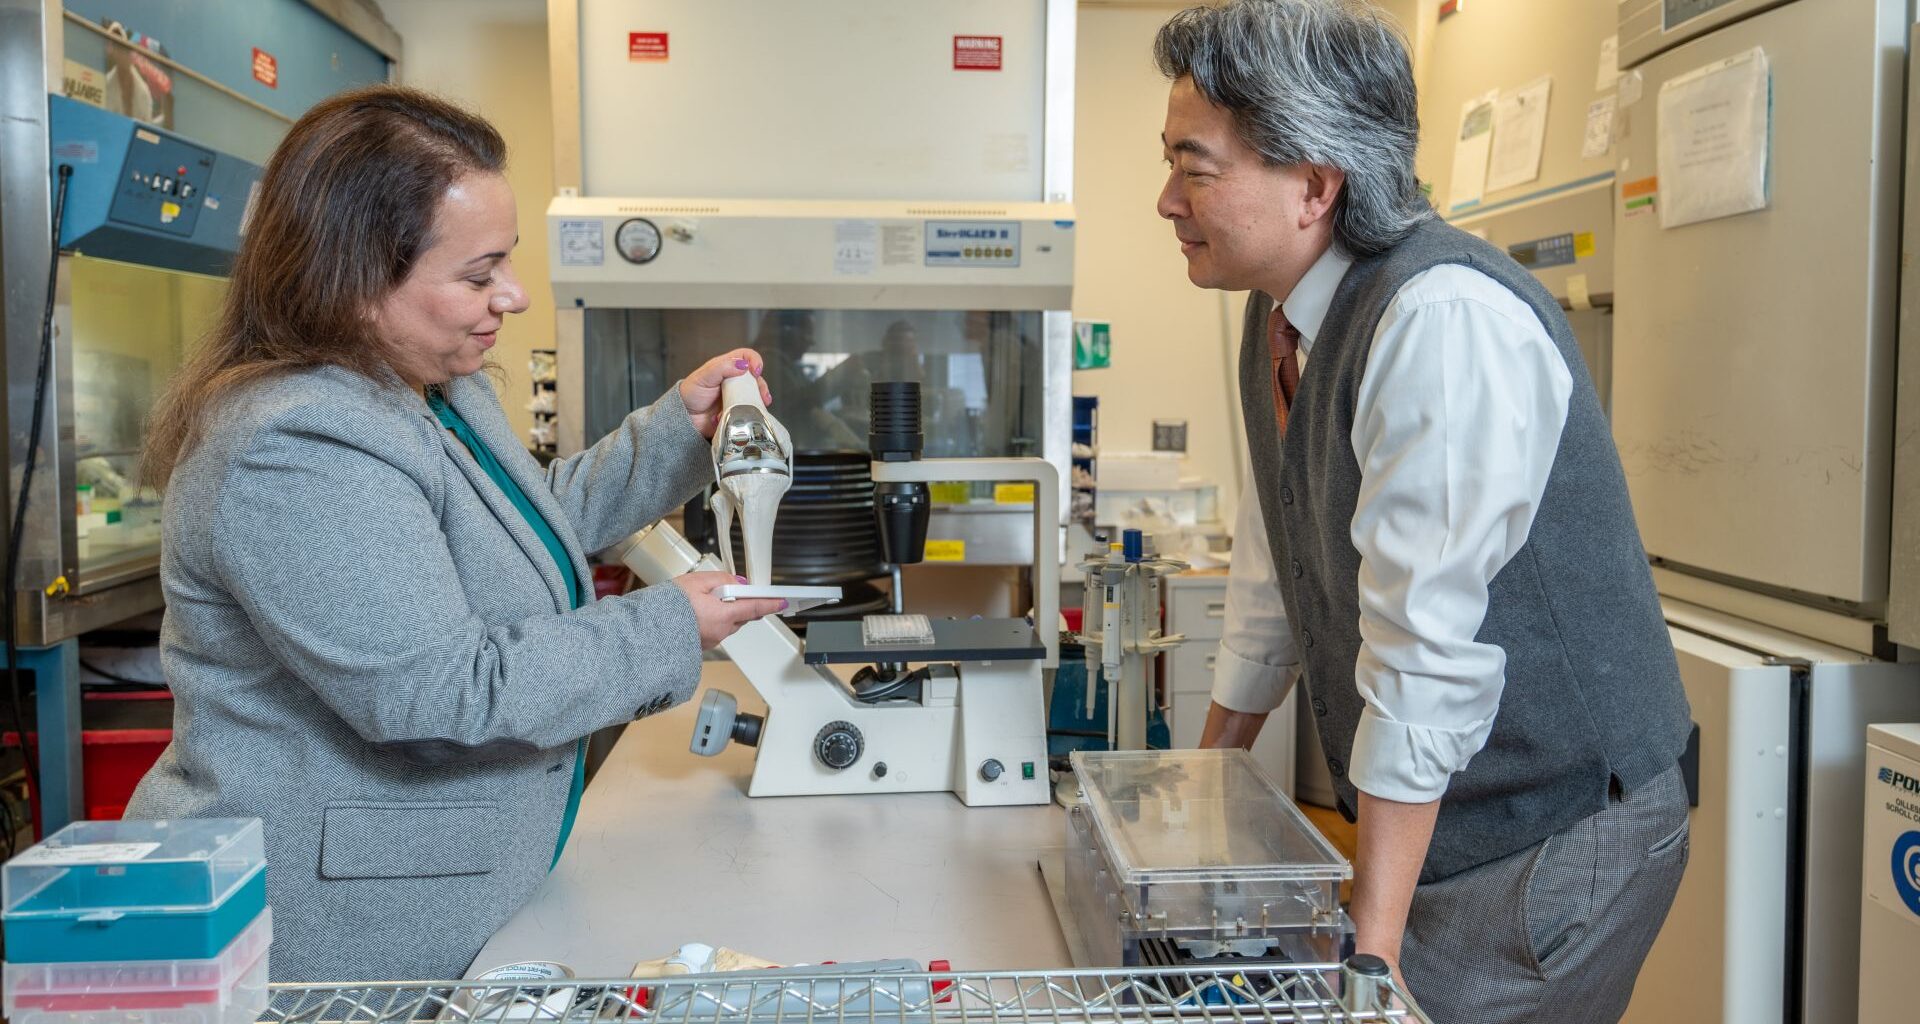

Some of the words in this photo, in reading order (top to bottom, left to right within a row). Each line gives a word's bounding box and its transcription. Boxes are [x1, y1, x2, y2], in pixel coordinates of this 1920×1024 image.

[958, 39, 999, 50] WARNING
[1886, 802, 1912, 820] SCROLL
[1895, 798, 1920, 815] OILLES
